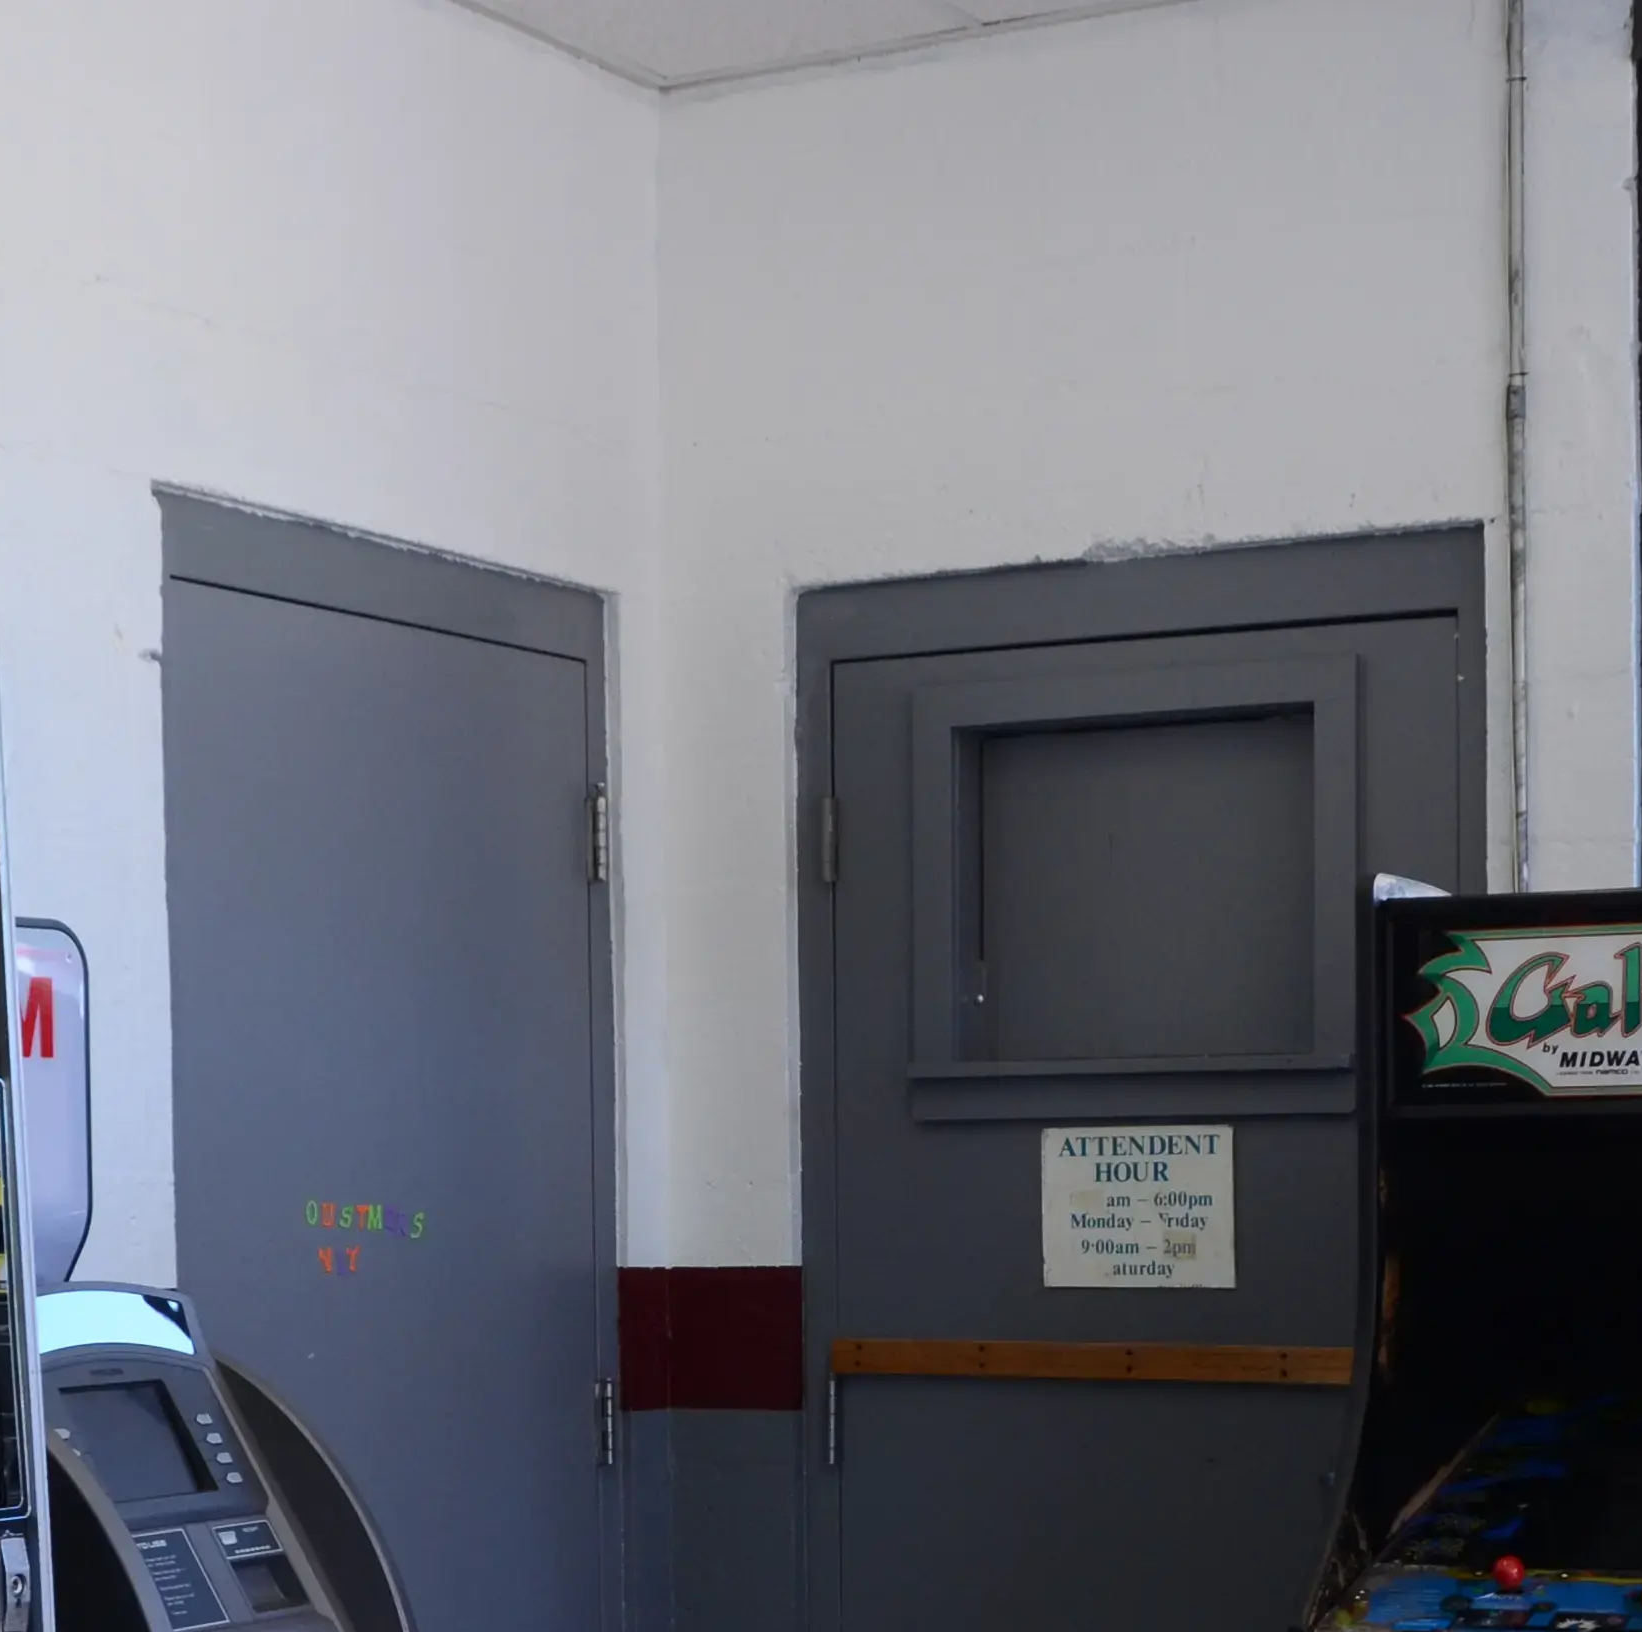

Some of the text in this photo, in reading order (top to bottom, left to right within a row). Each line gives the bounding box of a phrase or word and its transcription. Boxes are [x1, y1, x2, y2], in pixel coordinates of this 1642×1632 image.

[1542, 1043, 1559, 1054] by
[1058, 1133, 1221, 1157] ATTENDENT
[1094, 1161, 1170, 1183] HOUR
[1153, 1191, 1214, 1210] 6:00pm
[1070, 1213, 1134, 1231] Monday
